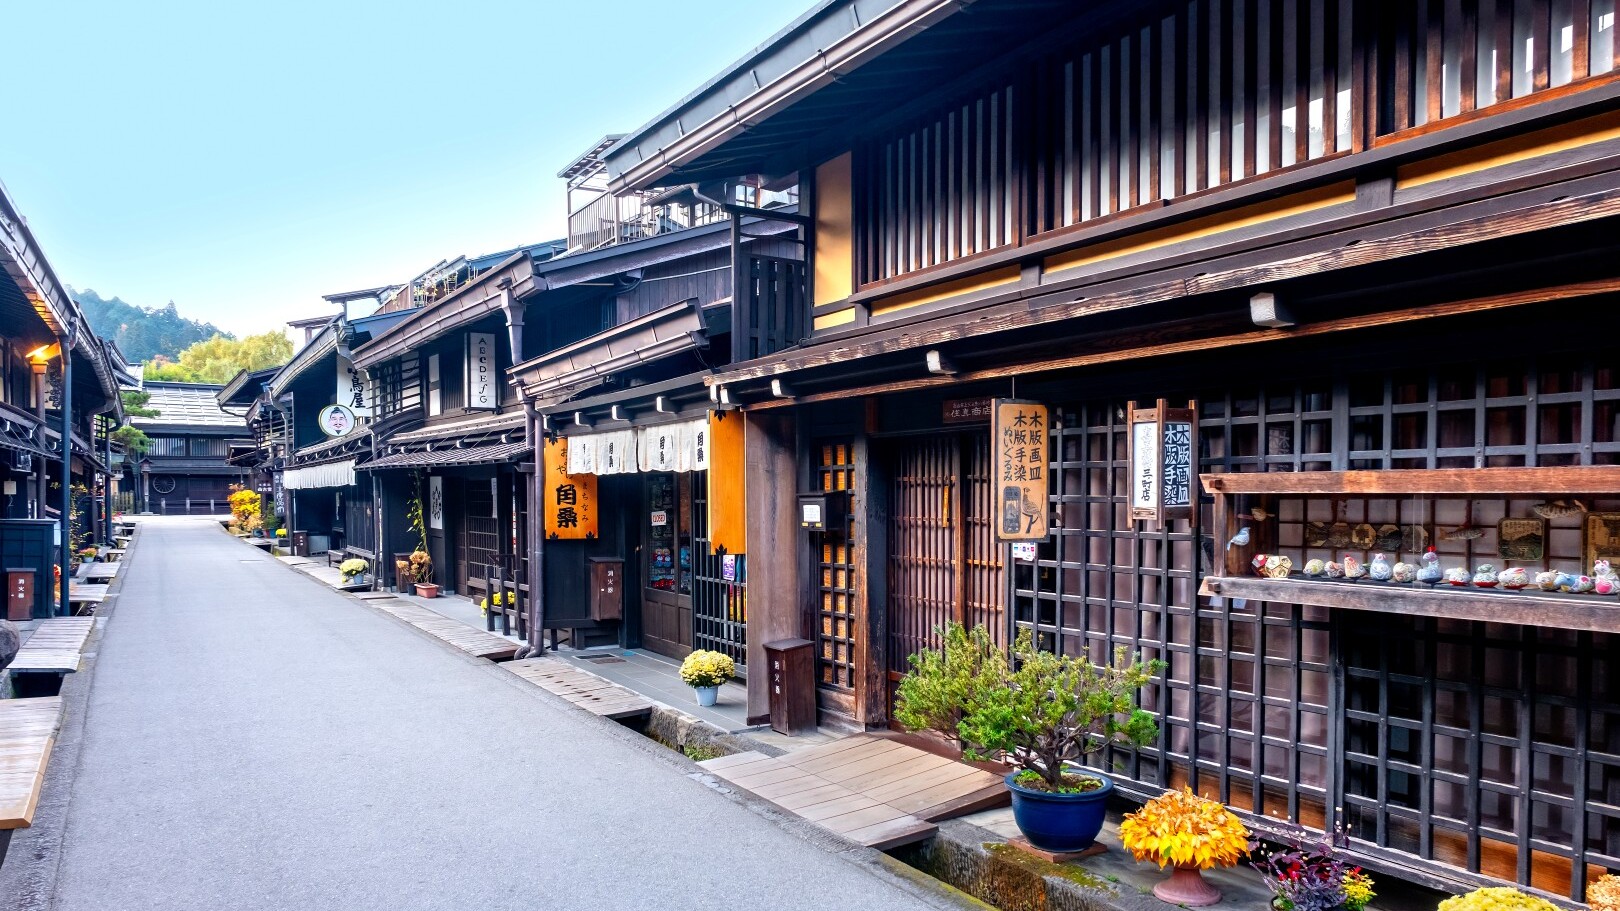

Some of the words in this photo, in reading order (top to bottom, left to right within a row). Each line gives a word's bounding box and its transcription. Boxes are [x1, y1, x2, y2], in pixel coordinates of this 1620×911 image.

[1003, 425, 1014, 482] ぬいぐるみ
[1013, 409, 1028, 482] 木版手染
[1028, 410, 1044, 481] 木版画皿
[1176, 424, 1190, 504] 木版画皿
[556, 484, 578, 529] 角桑
